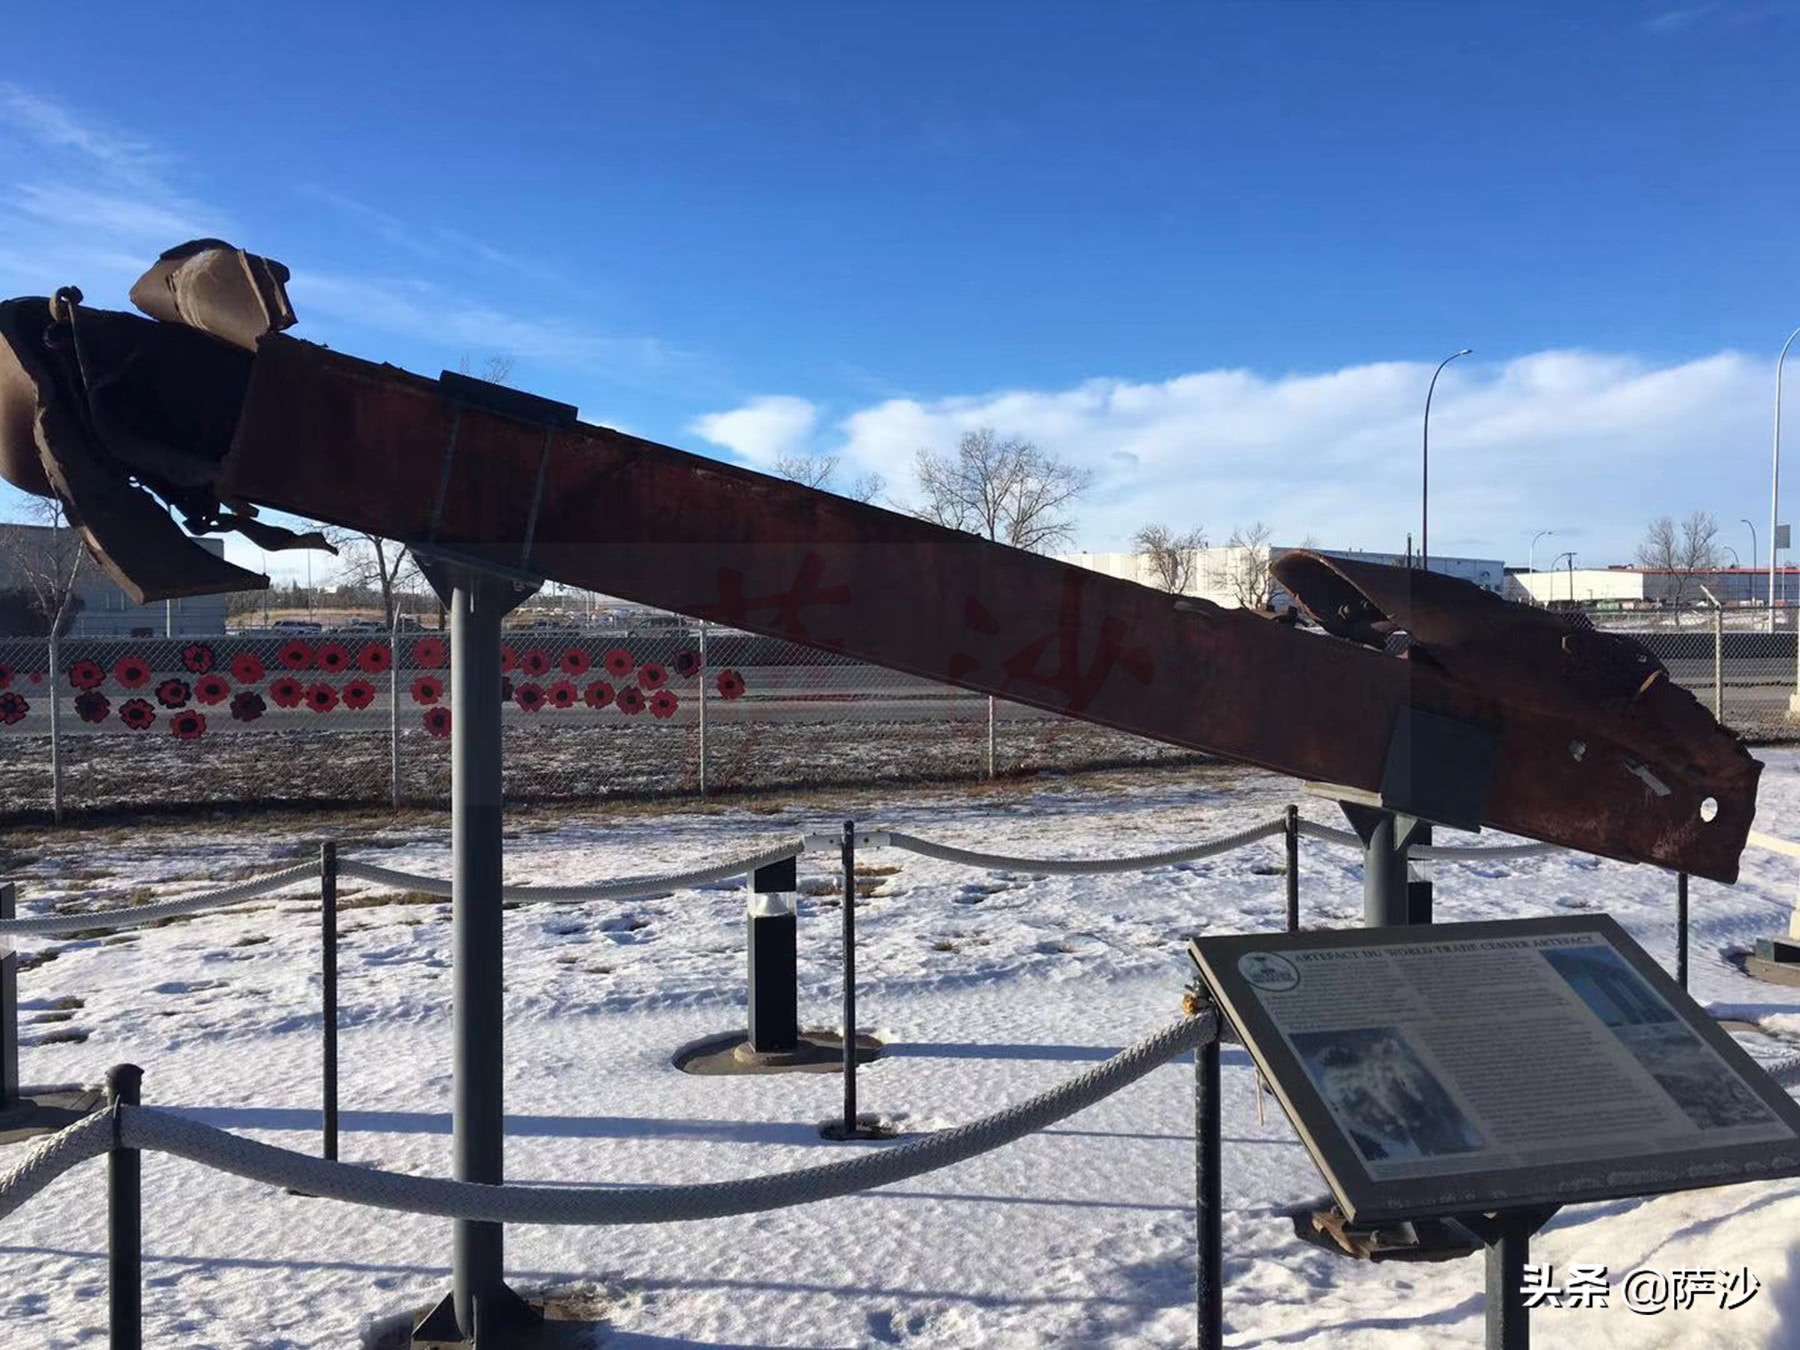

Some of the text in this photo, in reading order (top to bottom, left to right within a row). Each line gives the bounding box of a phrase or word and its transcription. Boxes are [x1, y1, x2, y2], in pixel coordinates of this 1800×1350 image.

[1385, 944, 1433, 957] WORLD
[1437, 942, 1477, 955] TRADE
[1480, 939, 1530, 951] CENTER
[1533, 934, 1594, 948] ARTEFACT
